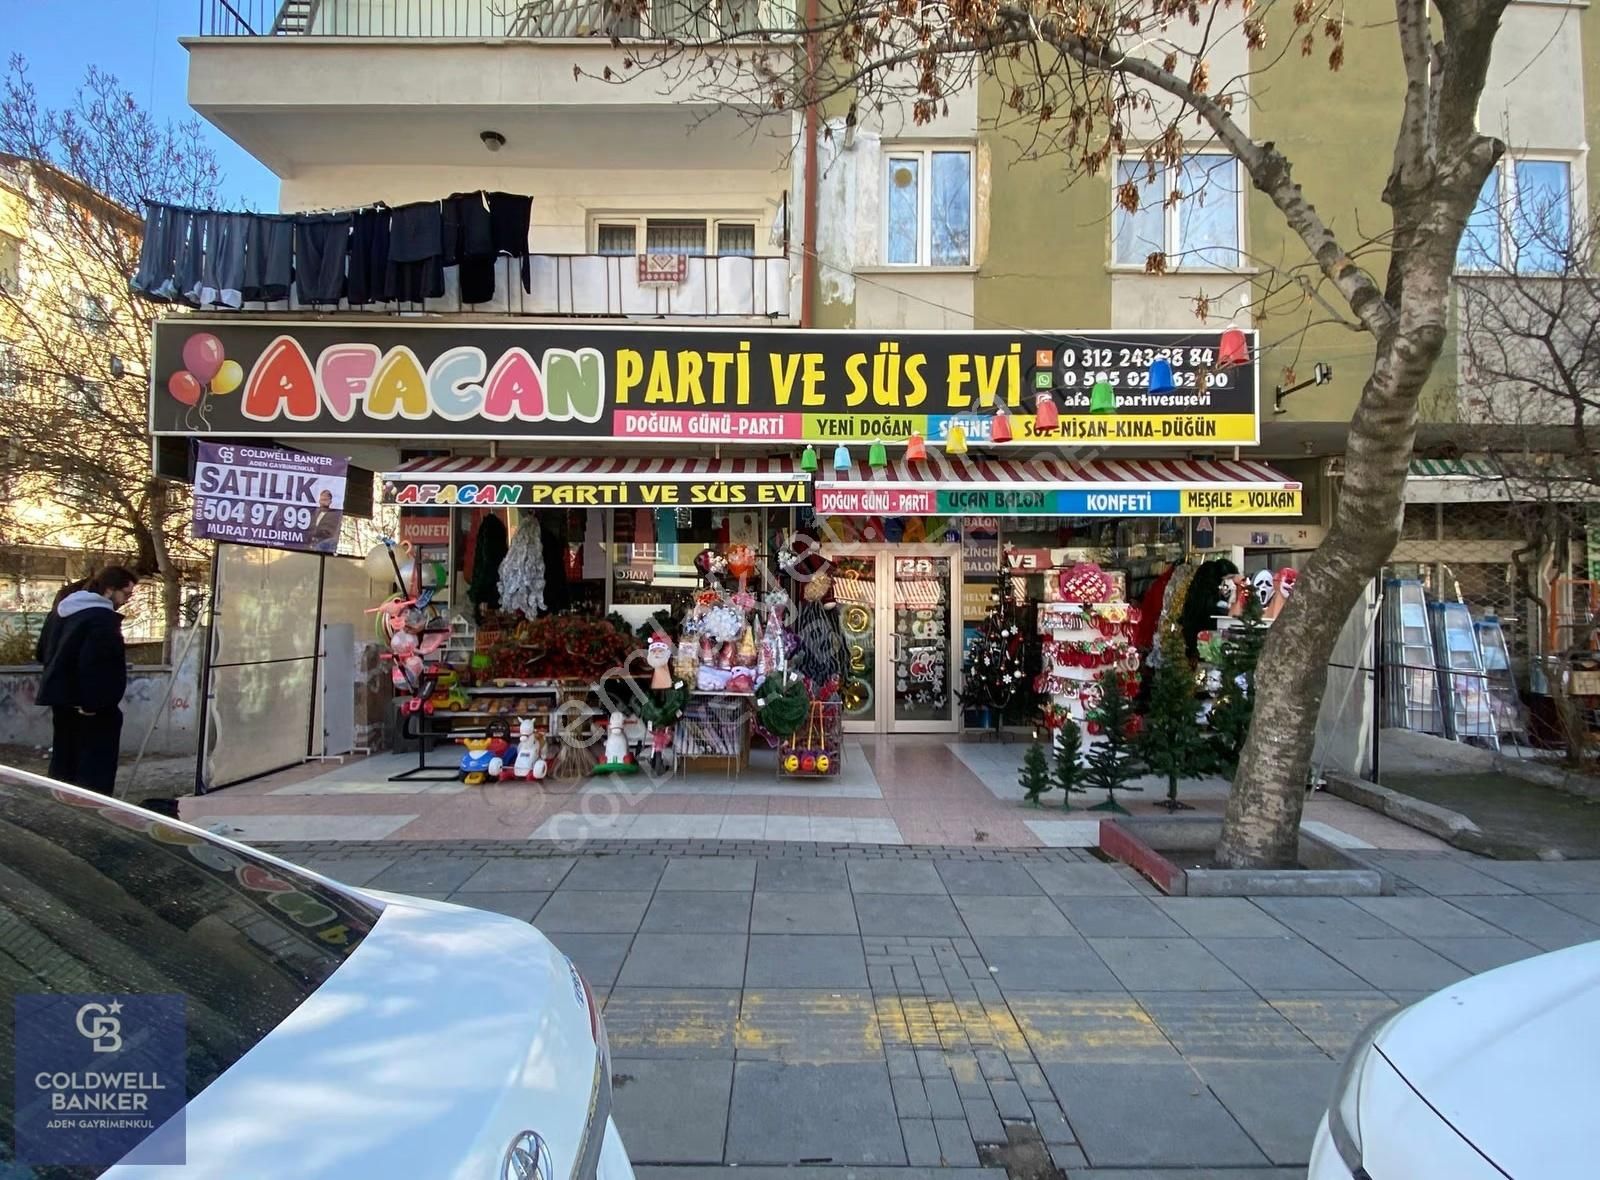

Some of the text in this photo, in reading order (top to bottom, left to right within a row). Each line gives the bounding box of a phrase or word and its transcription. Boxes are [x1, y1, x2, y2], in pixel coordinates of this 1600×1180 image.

[1064, 348, 1075, 368] 0
[1081, 348, 1112, 368] 312
[1190, 348, 1213, 367] 84
[241, 334, 1021, 423] AFACAN PARTİ VE SÜS EVİ
[1064, 371, 1076, 386] 0
[625, 413, 683, 435] DOĞUM
[688, 413, 785, 437] GÜNÜ-PARTİ
[815, 417, 855, 436] YENİ
[859, 417, 912, 437] DOĞAN
[240, 448, 333, 467] COLDWELL BANKER
[248, 460, 268, 468] ADEN
[200, 466, 318, 503] SATILIK
[396, 481, 806, 504] AFACAN PARTİ VE SÜS EVİ
[822, 490, 858, 511] DOĞUM
[861, 490, 890, 511] GÜNÜ
[900, 491, 929, 512] PARTİ
[994, 490, 1045, 508] BALON
[1086, 491, 1152, 512] KONFETİ
[1187, 491, 1233, 512] MEŞALE
[1248, 491, 1295, 508] VOLKAN
[203, 498, 312, 530] 504 97 99
[207, 523, 303, 543] MURAT YILDIRIM
